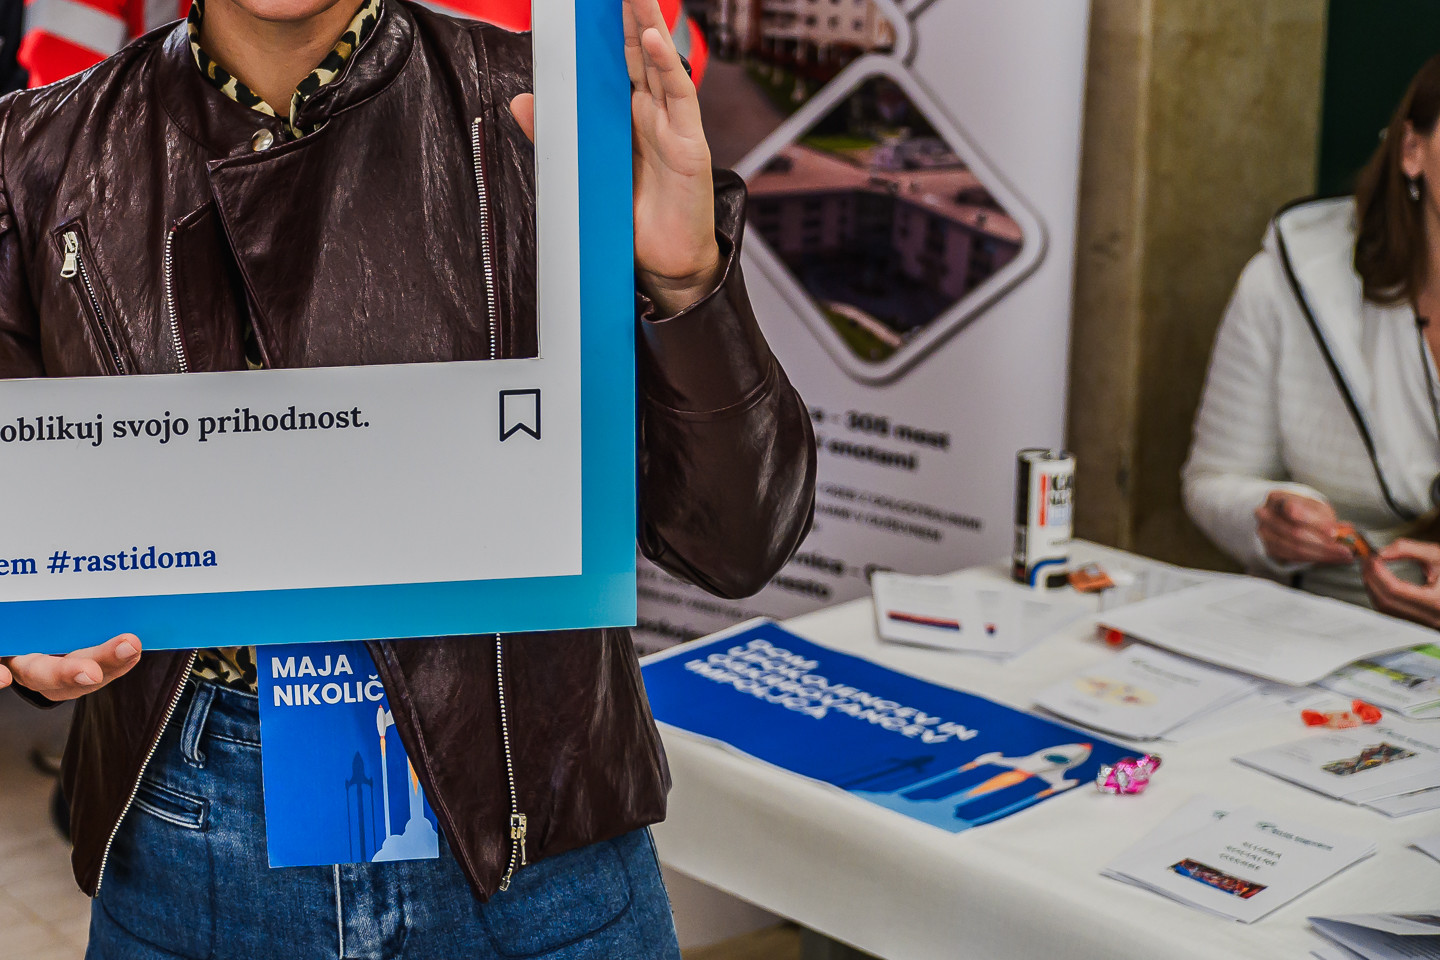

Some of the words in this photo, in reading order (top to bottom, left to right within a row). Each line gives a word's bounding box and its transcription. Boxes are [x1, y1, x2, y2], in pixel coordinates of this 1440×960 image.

[0, 414, 103, 447] oblikuj
[113, 411, 189, 444] svojo
[198, 406, 370, 442] prihodnost.
[47, 546, 218, 574] #rastidoma
[271, 654, 354, 679] MAJA
[272, 674, 384, 707] NIKOLIČ
